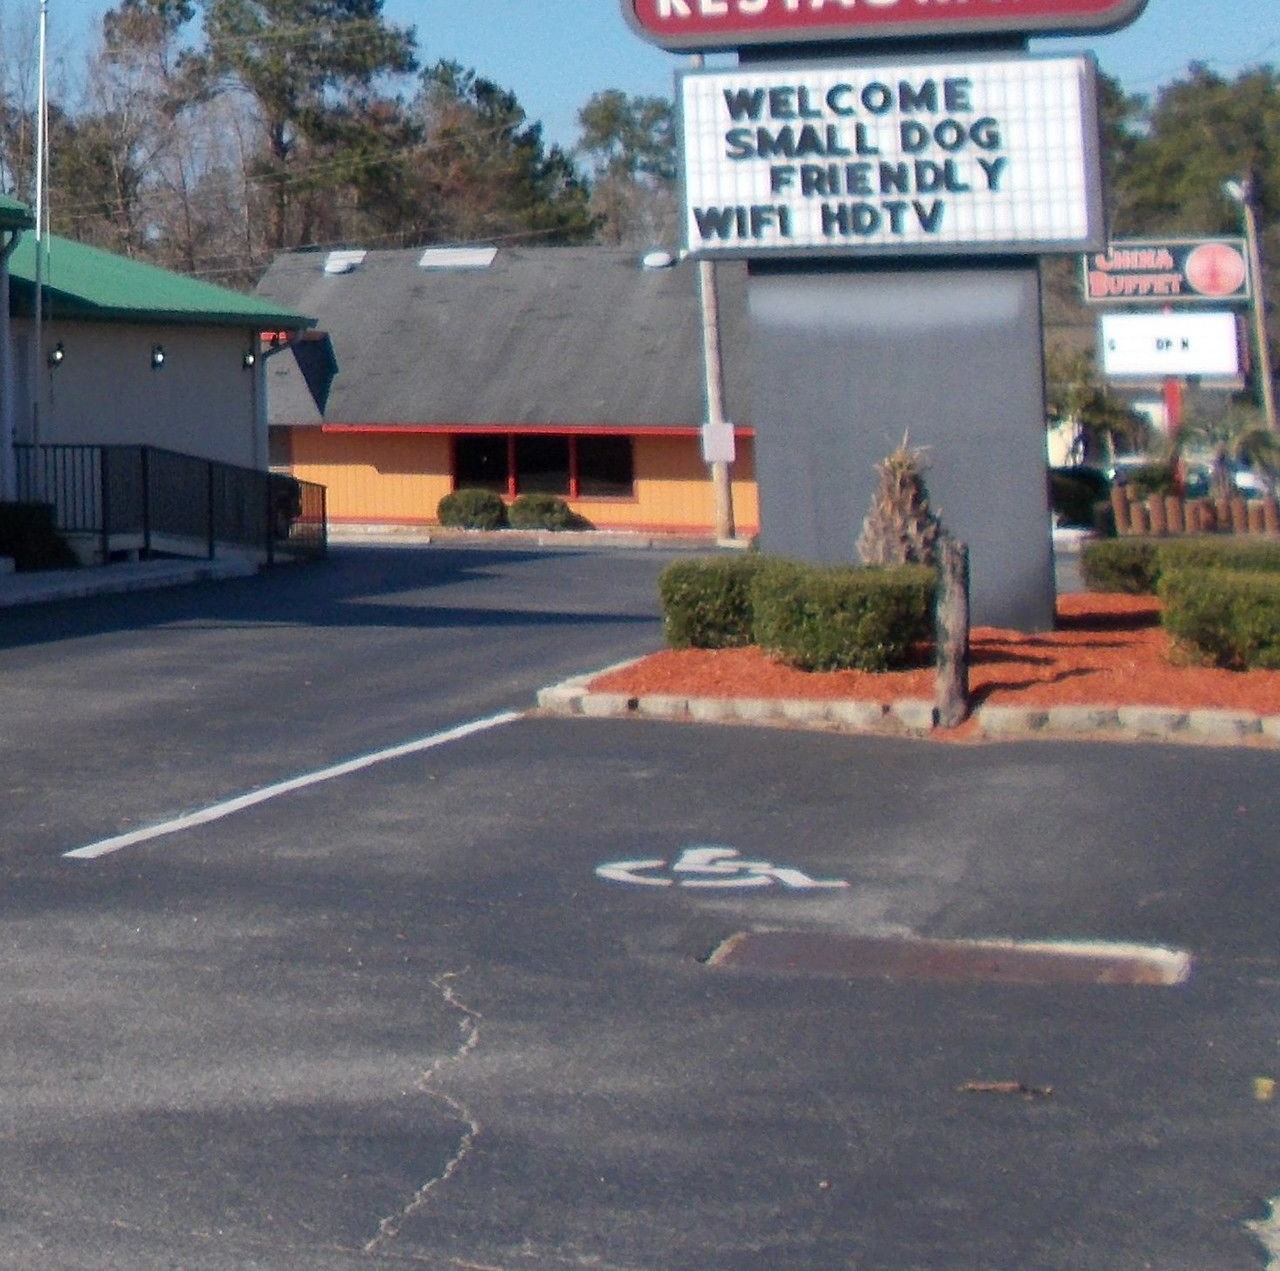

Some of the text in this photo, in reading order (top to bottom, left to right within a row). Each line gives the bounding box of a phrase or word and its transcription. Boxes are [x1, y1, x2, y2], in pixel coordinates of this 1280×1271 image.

[723, 77, 974, 121] WELCOME
[725, 117, 1001, 160] SMALL DOG
[770, 157, 1008, 197] FRIENDLY
[692, 199, 945, 240] WIFI HDTV
[1095, 248, 1174, 271] CHINA
[1089, 271, 1183, 297] BUFFET
